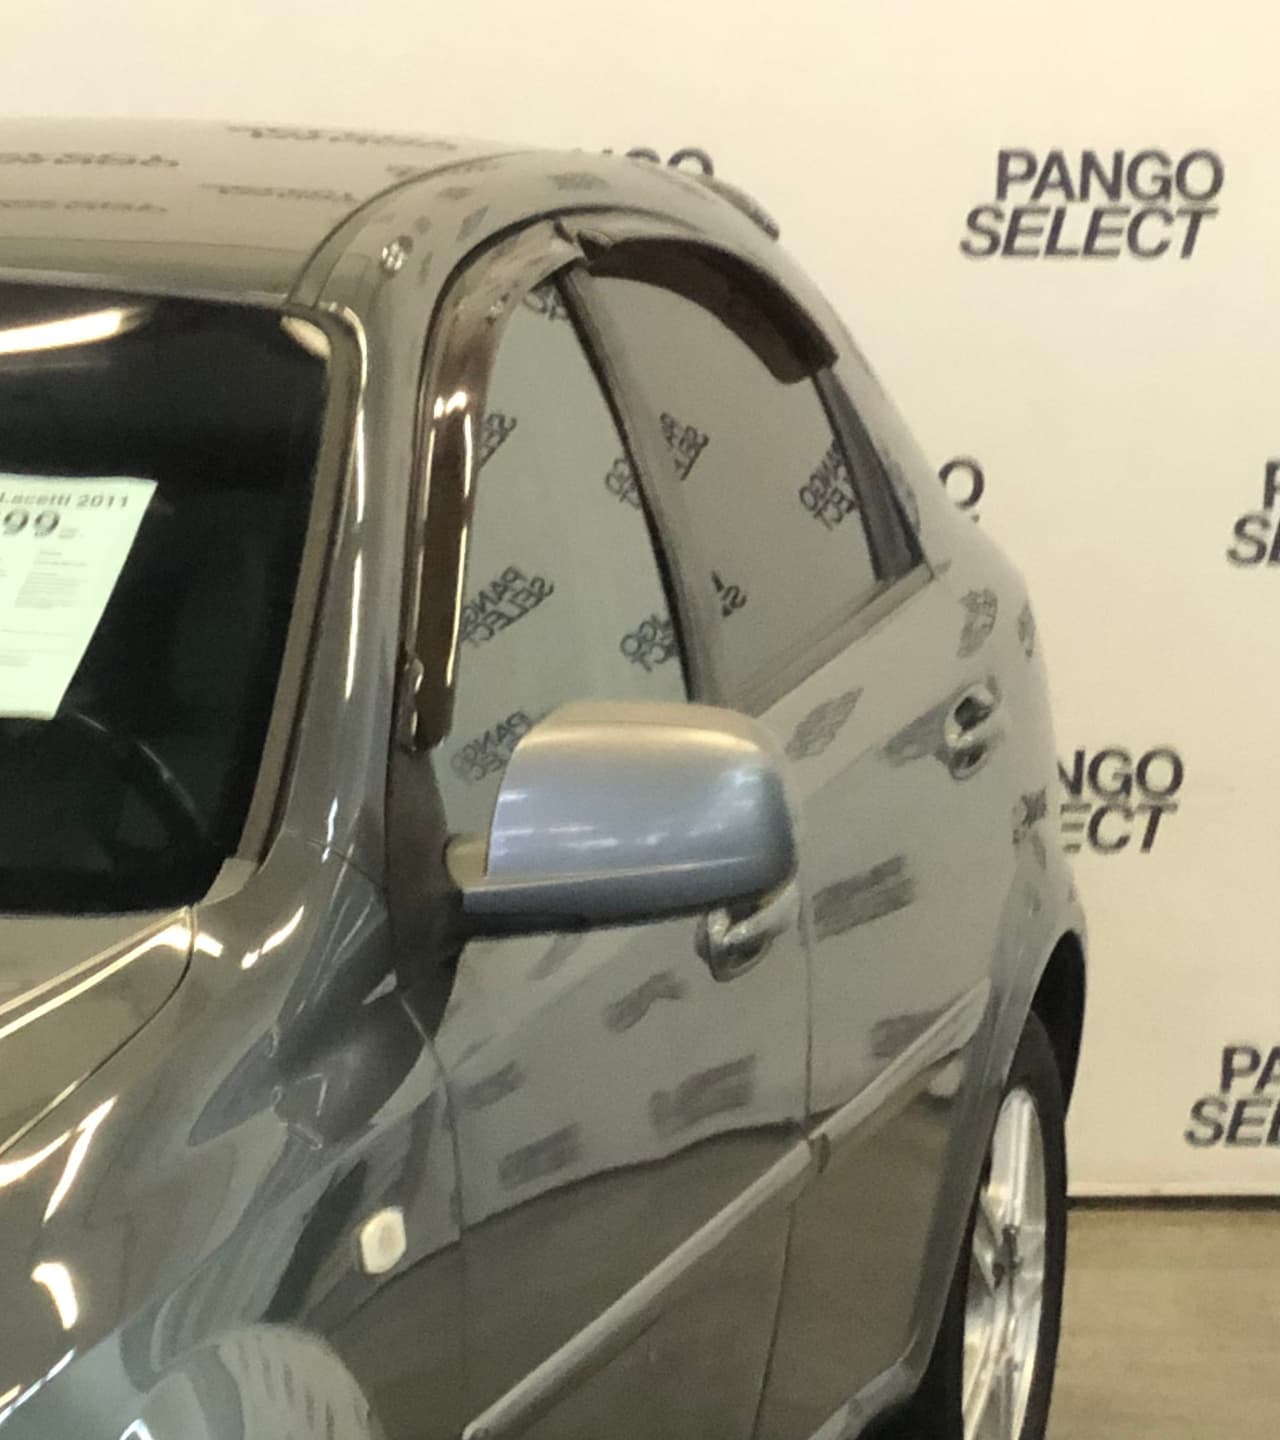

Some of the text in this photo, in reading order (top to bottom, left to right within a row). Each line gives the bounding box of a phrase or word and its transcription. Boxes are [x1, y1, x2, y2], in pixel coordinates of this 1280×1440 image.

[996, 150, 1224, 204] PANGO
[959, 206, 1219, 259] SELECT
[76, 494, 130, 508] 2011
